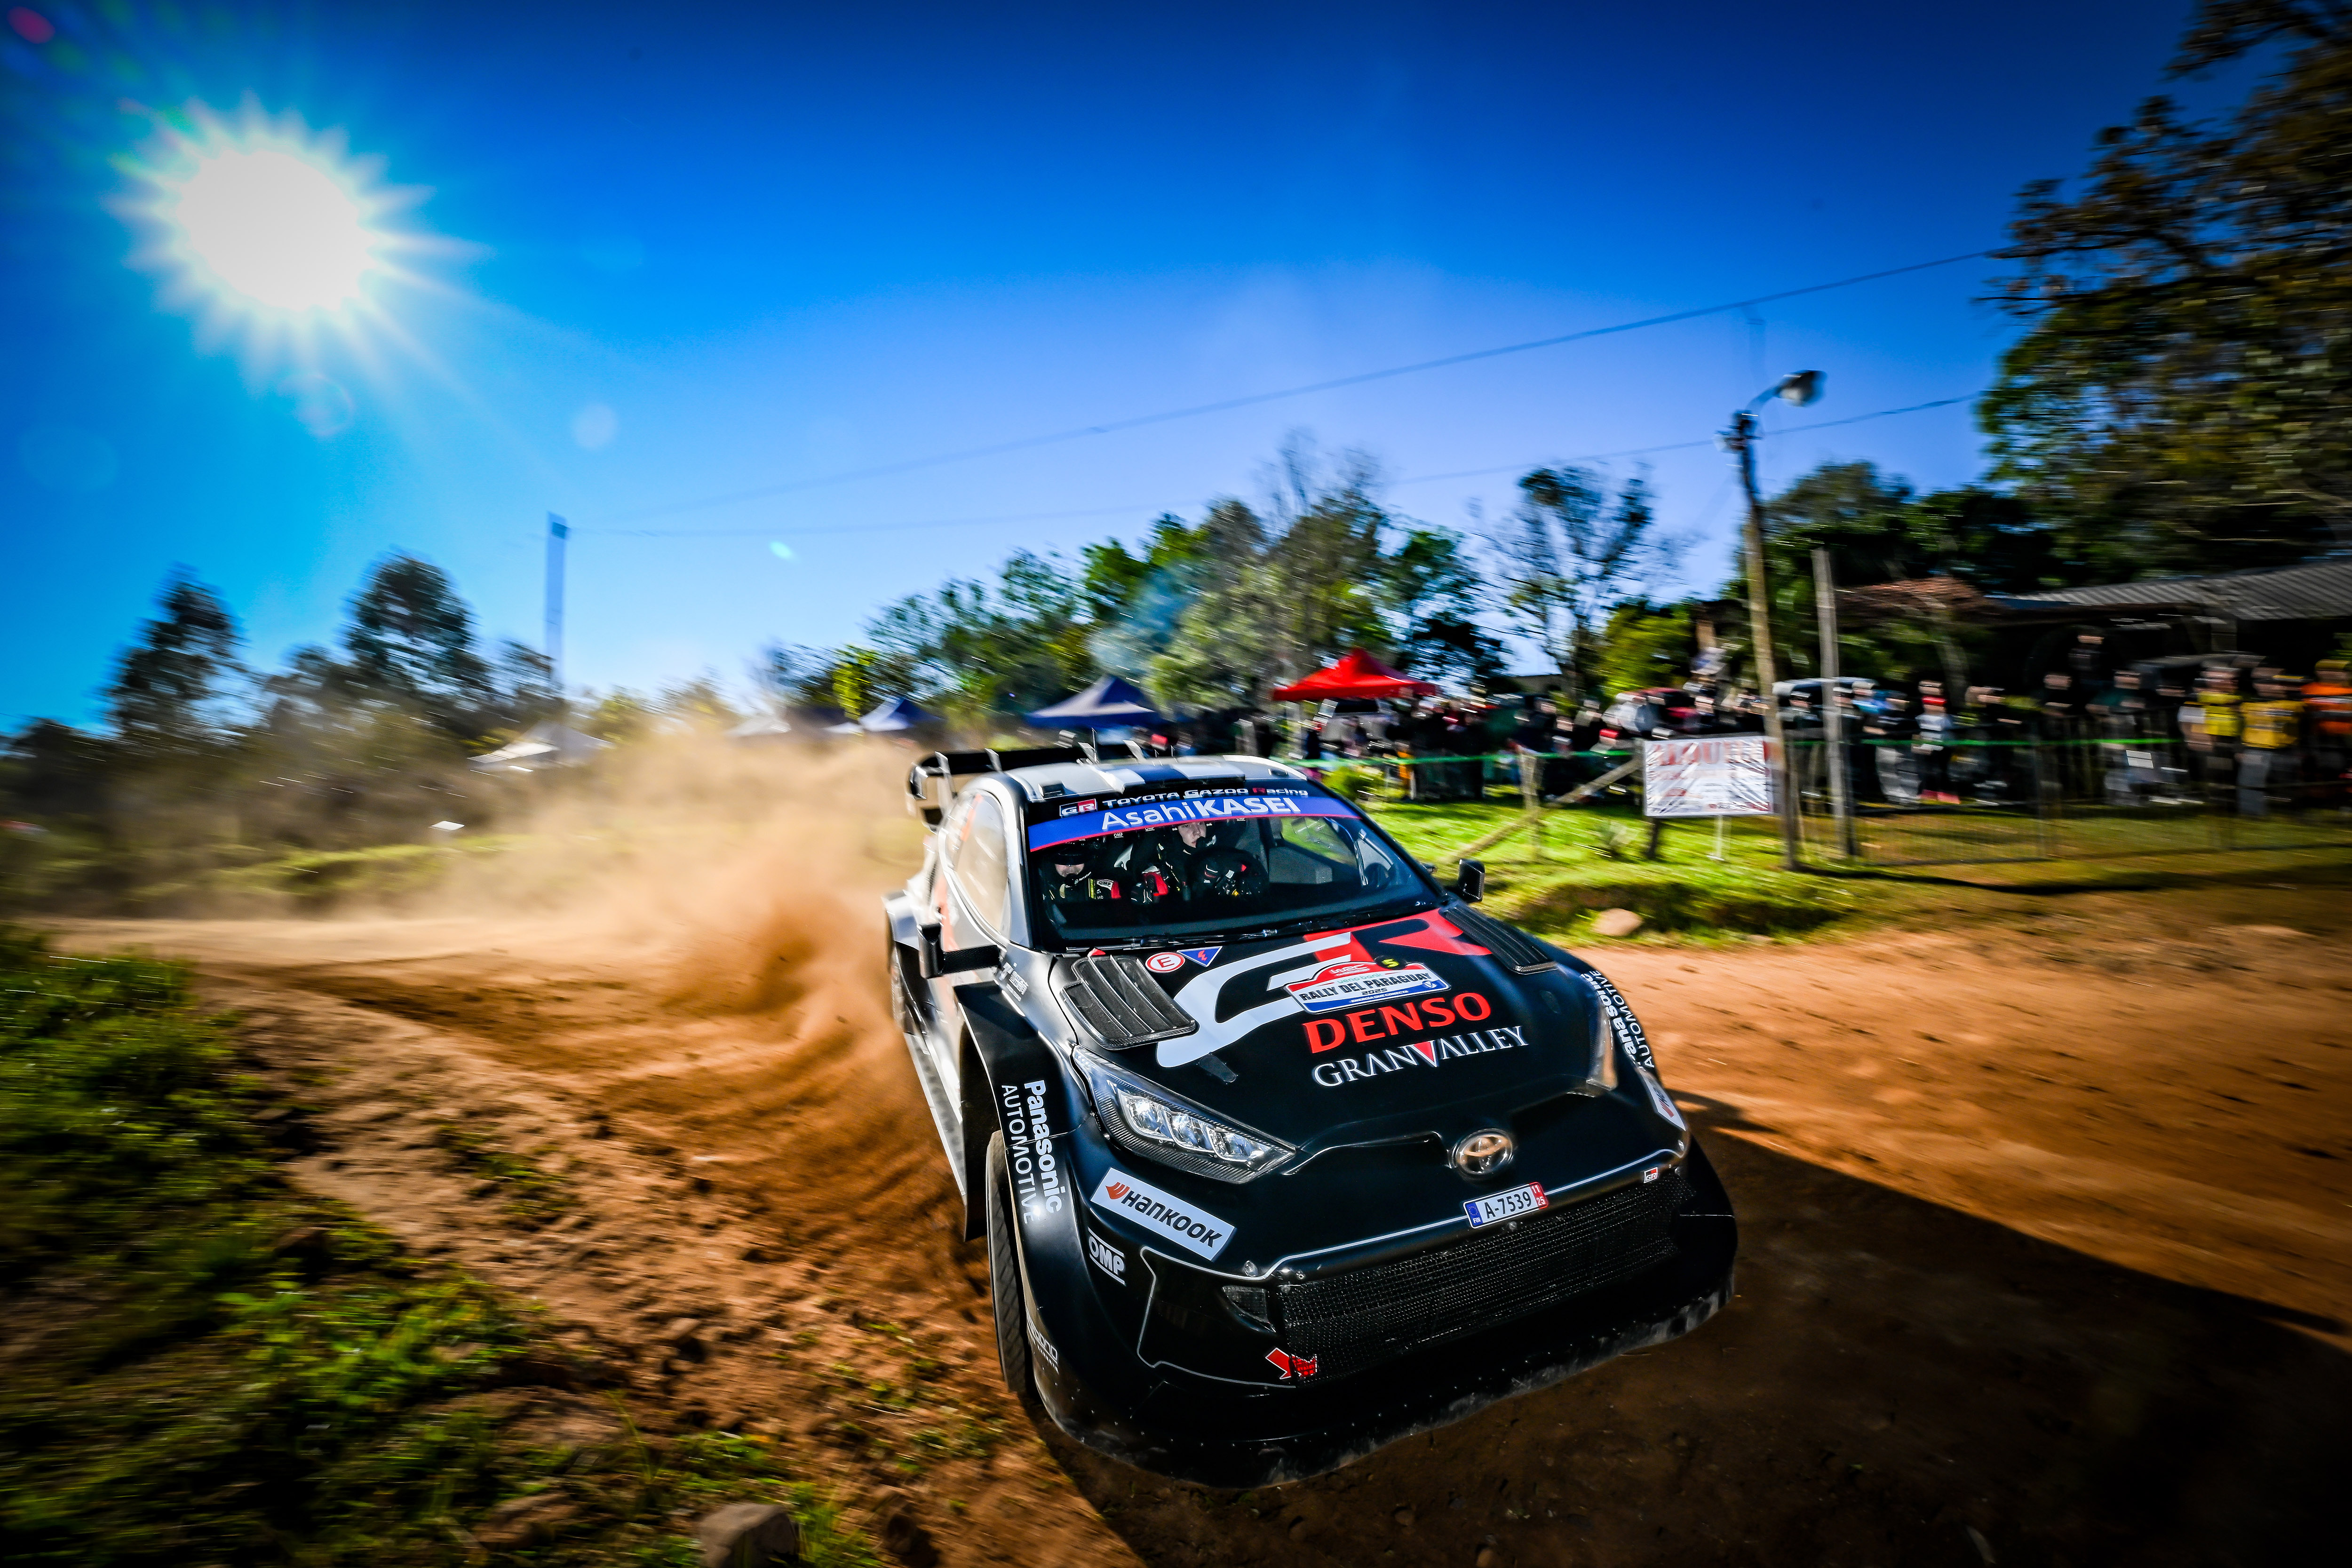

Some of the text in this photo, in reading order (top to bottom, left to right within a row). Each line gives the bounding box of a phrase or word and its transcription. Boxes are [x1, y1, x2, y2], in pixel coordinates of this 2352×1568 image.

[1061, 803, 1095, 815] GR
[1103, 792, 1179, 807] TOYOTA
[1184, 788, 1249, 797] GAZOO
[1157, 957, 1175, 968] E
[1330, 964, 1368, 973] WRC
[1382, 959, 1399, 967] 5
[1299, 987, 1338, 1001] RALLY
[1338, 982, 1366, 993] DEL
[1363, 972, 1432, 989] PARAGUAY
[1302, 993, 1491, 1053] DENSO
[1589, 971, 1654, 1068] AUTOMOTIVE
[1313, 1026, 1529, 1087] GRANVALLEY
[1025, 1080, 1065, 1213] Panasonic
[1531, 1185, 1540, 1194] 11
[1536, 1196, 1546, 1206] 25
[1484, 1191, 1532, 1218] A-7539
[1089, 1235, 1125, 1275] OMP
